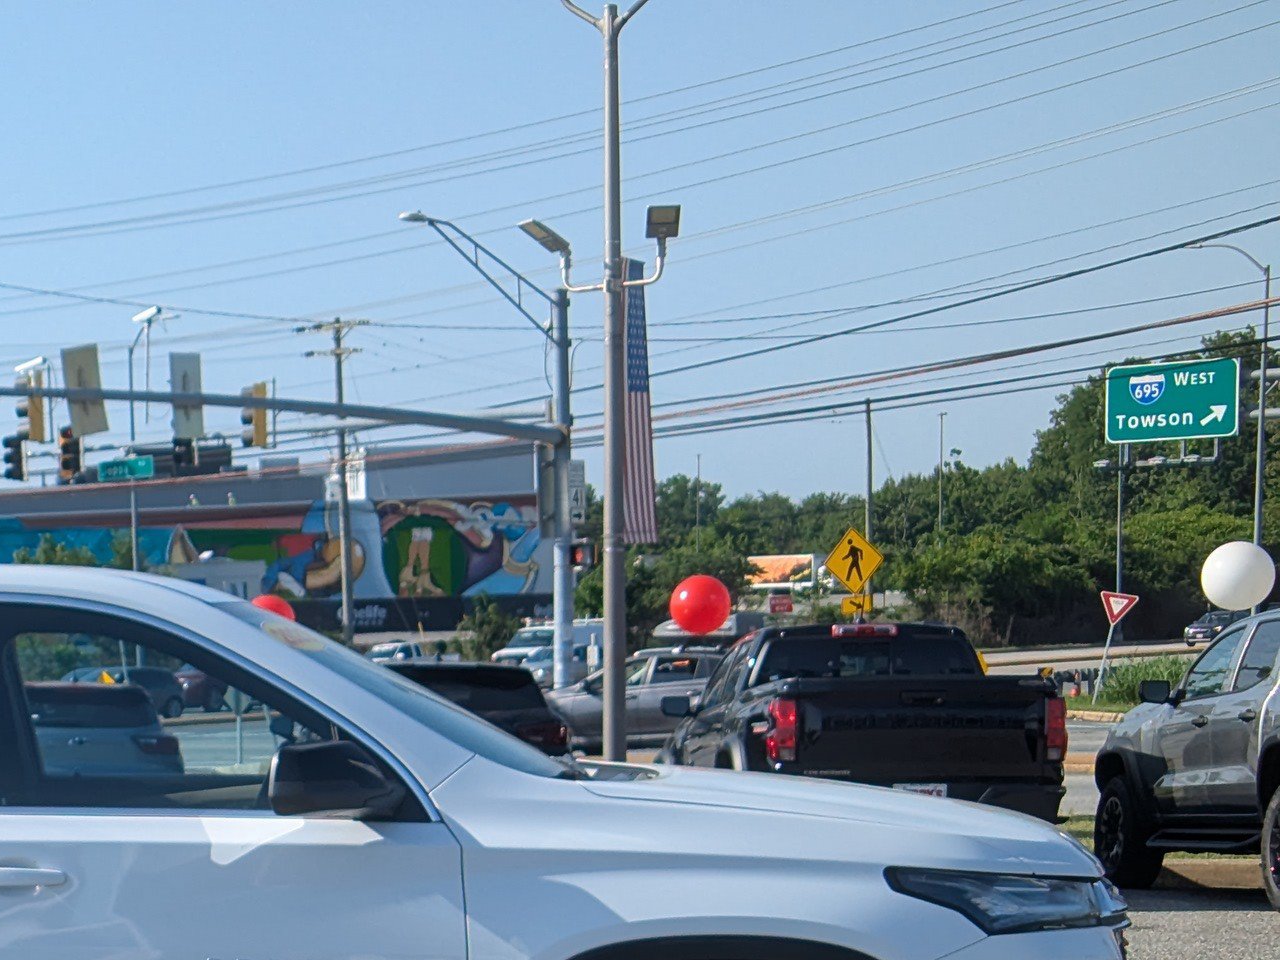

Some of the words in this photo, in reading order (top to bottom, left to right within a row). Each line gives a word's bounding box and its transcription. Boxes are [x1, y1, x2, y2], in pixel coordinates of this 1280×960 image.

[1173, 371, 1216, 386] WEST
[1134, 383, 1160, 399] 695
[1115, 412, 1194, 430] Towson
